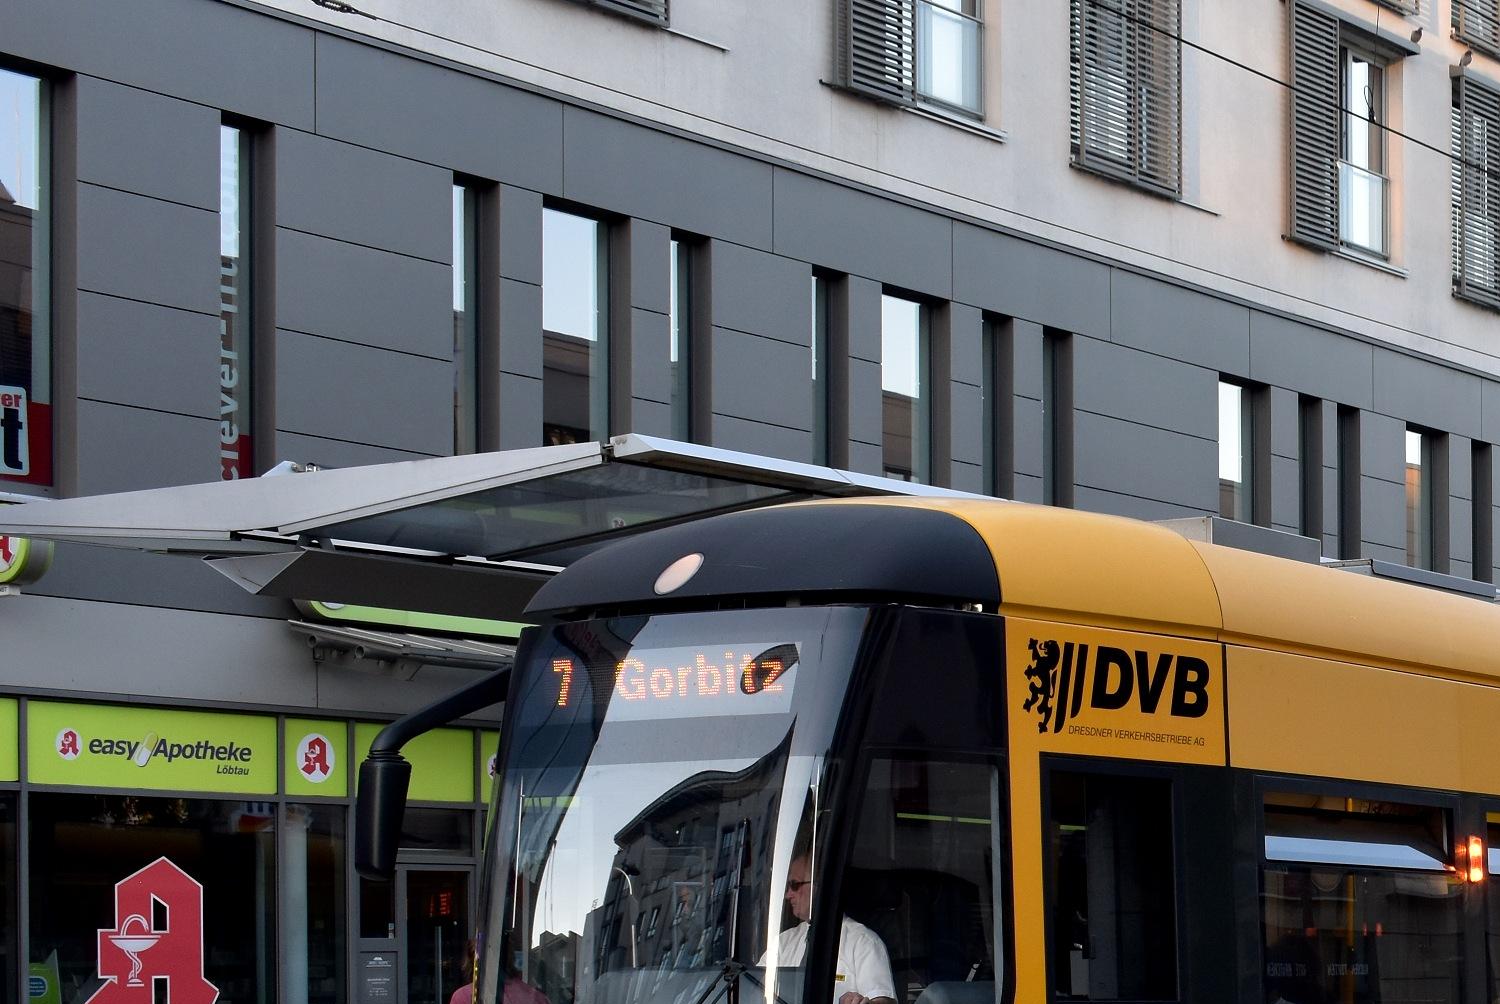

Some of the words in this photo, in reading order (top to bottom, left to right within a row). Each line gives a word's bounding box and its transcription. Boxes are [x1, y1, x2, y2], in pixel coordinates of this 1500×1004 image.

[0, 392, 22, 408] er
[553, 659, 573, 706] 7
[615, 652, 784, 700] Gorbitz
[1091, 645, 1210, 718] DVB
[1069, 725, 1112, 738] DRESDNER
[1114, 729, 1192, 746] VERKEHRSBETRIEBE
[1194, 737, 1205, 747] AG
[153, 738, 252, 762] Apotheke
[216, 764, 250, 776] Löbtau
